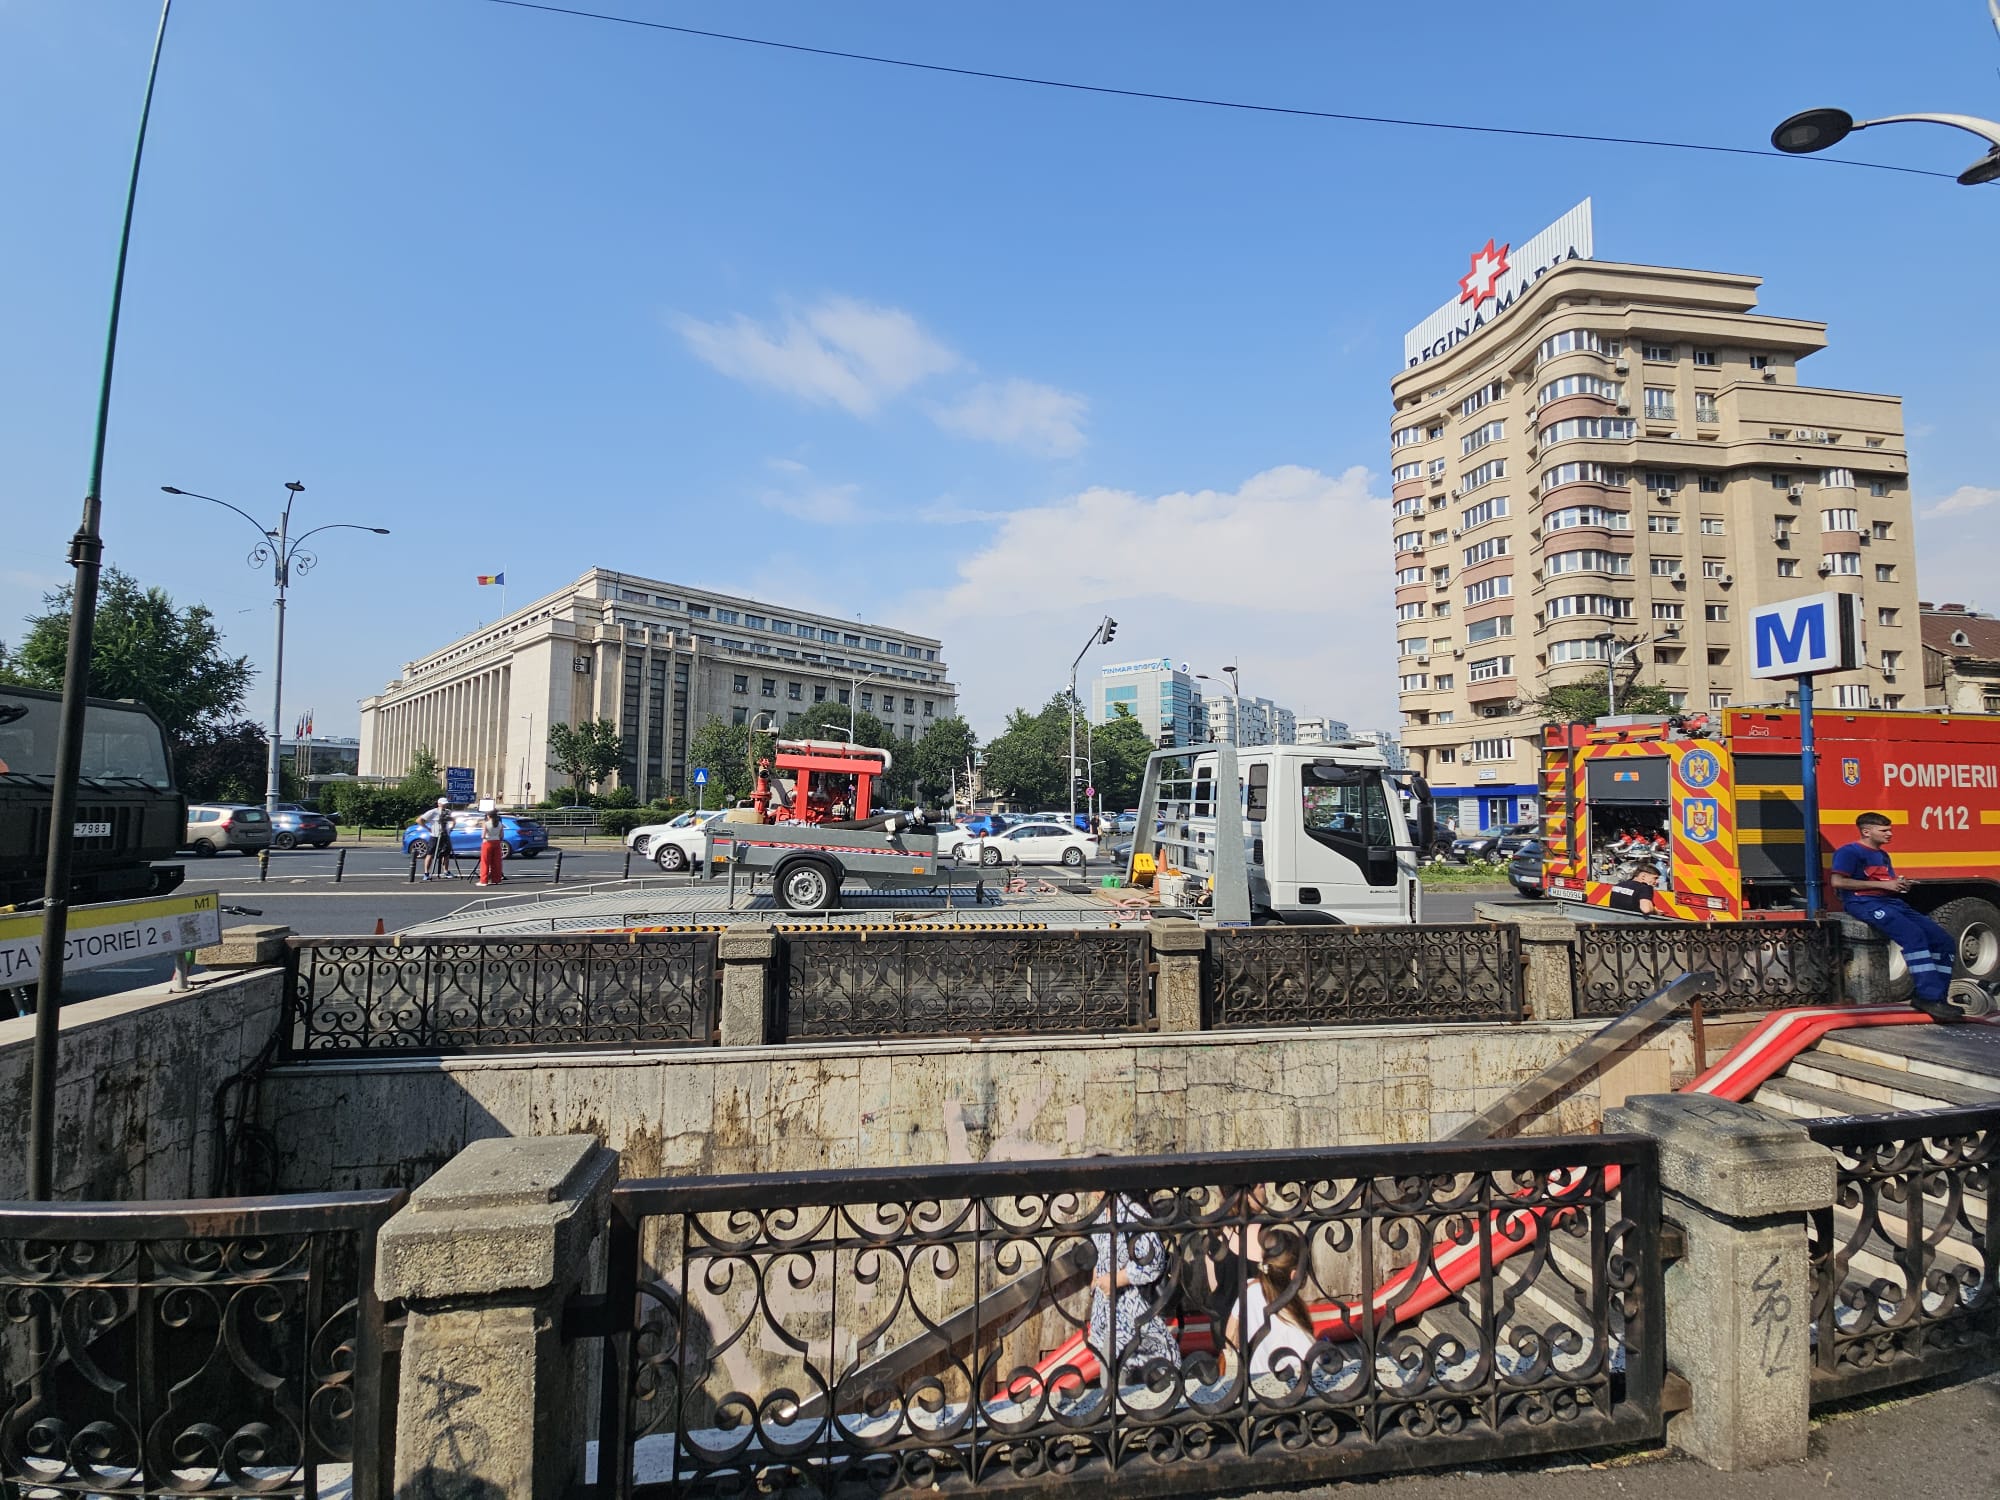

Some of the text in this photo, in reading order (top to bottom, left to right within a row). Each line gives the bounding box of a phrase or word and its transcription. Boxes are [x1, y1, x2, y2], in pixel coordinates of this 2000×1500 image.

[1755, 603, 1826, 668] M
[1883, 763, 1998, 788] POMPIERII
[1933, 806, 1970, 830] 112
[194, 897, 210, 910] M1
[147, 927, 157, 945] 2
